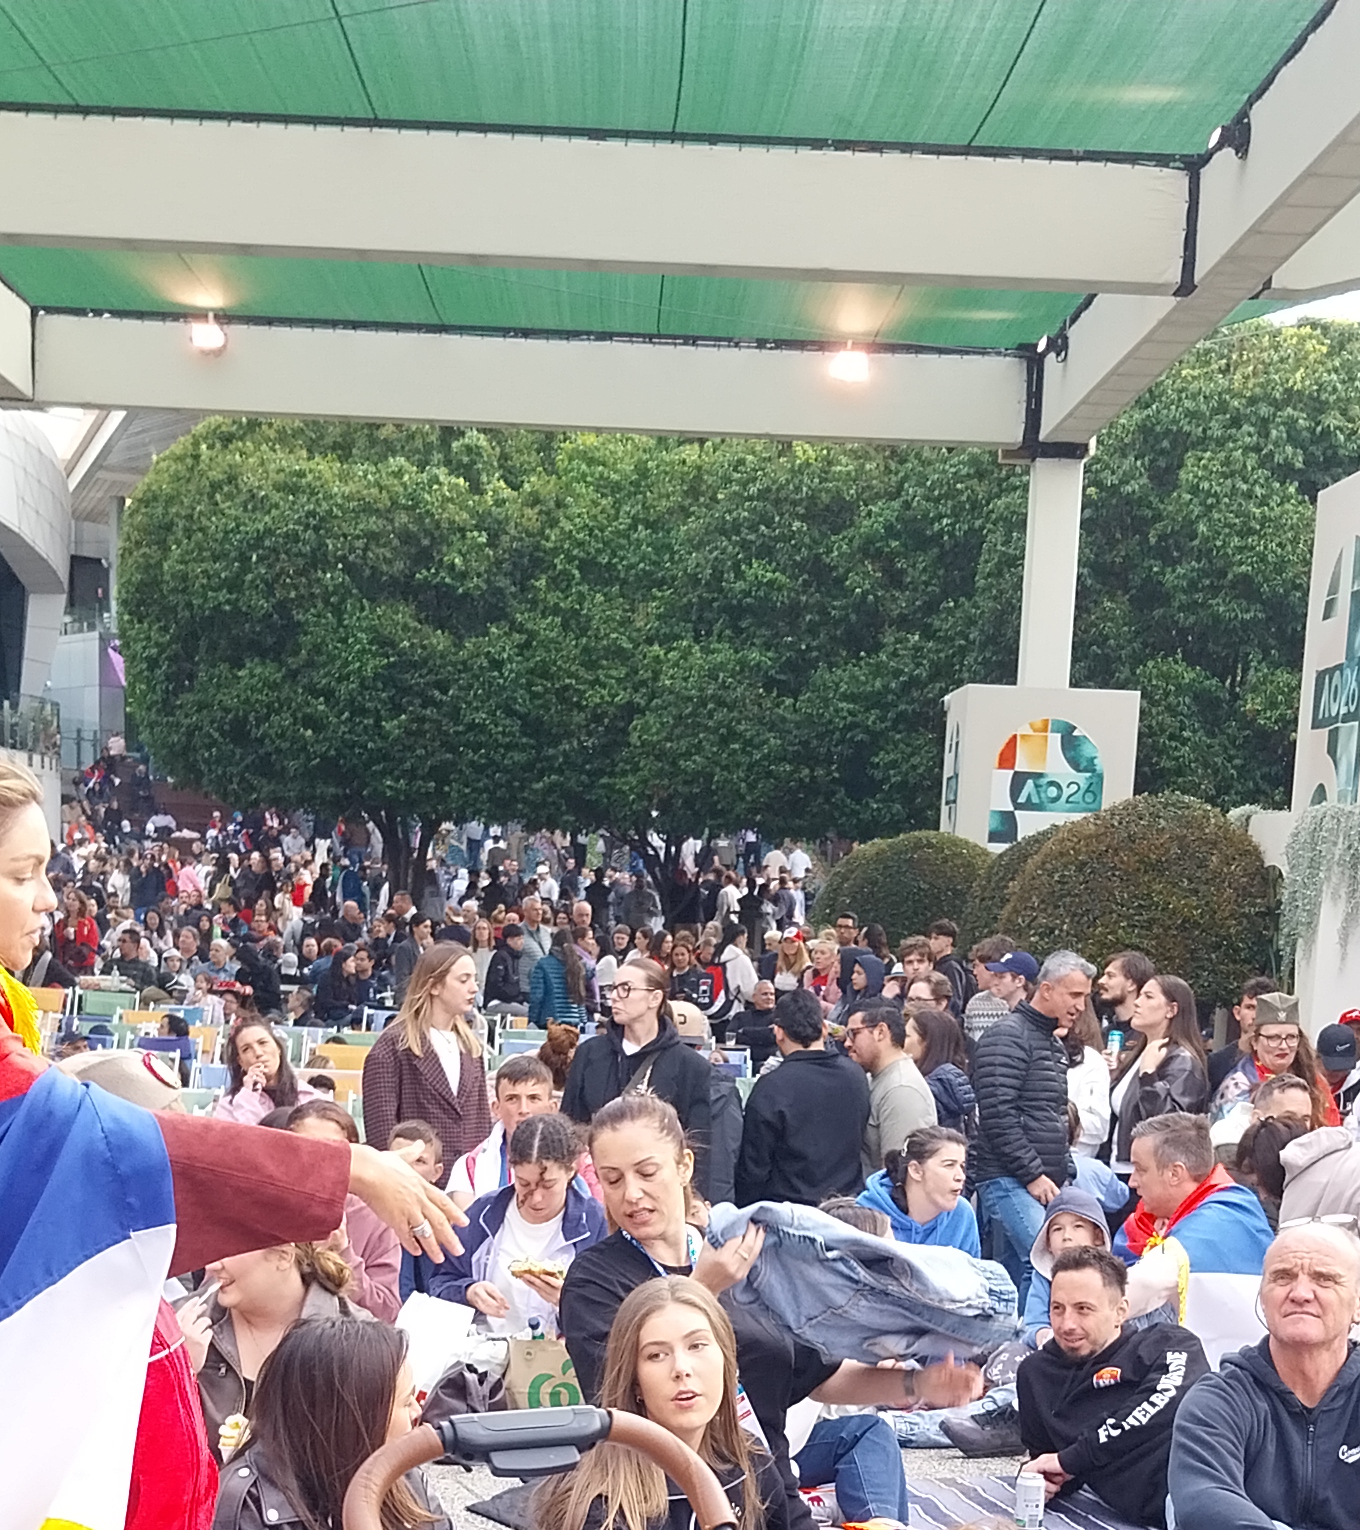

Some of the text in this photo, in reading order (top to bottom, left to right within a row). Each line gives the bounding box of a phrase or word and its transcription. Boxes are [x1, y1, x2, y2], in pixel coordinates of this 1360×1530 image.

[1318, 665, 1359, 720] AO26
[1016, 779, 1098, 806] AO26
[1097, 1418, 1123, 1444] FC
